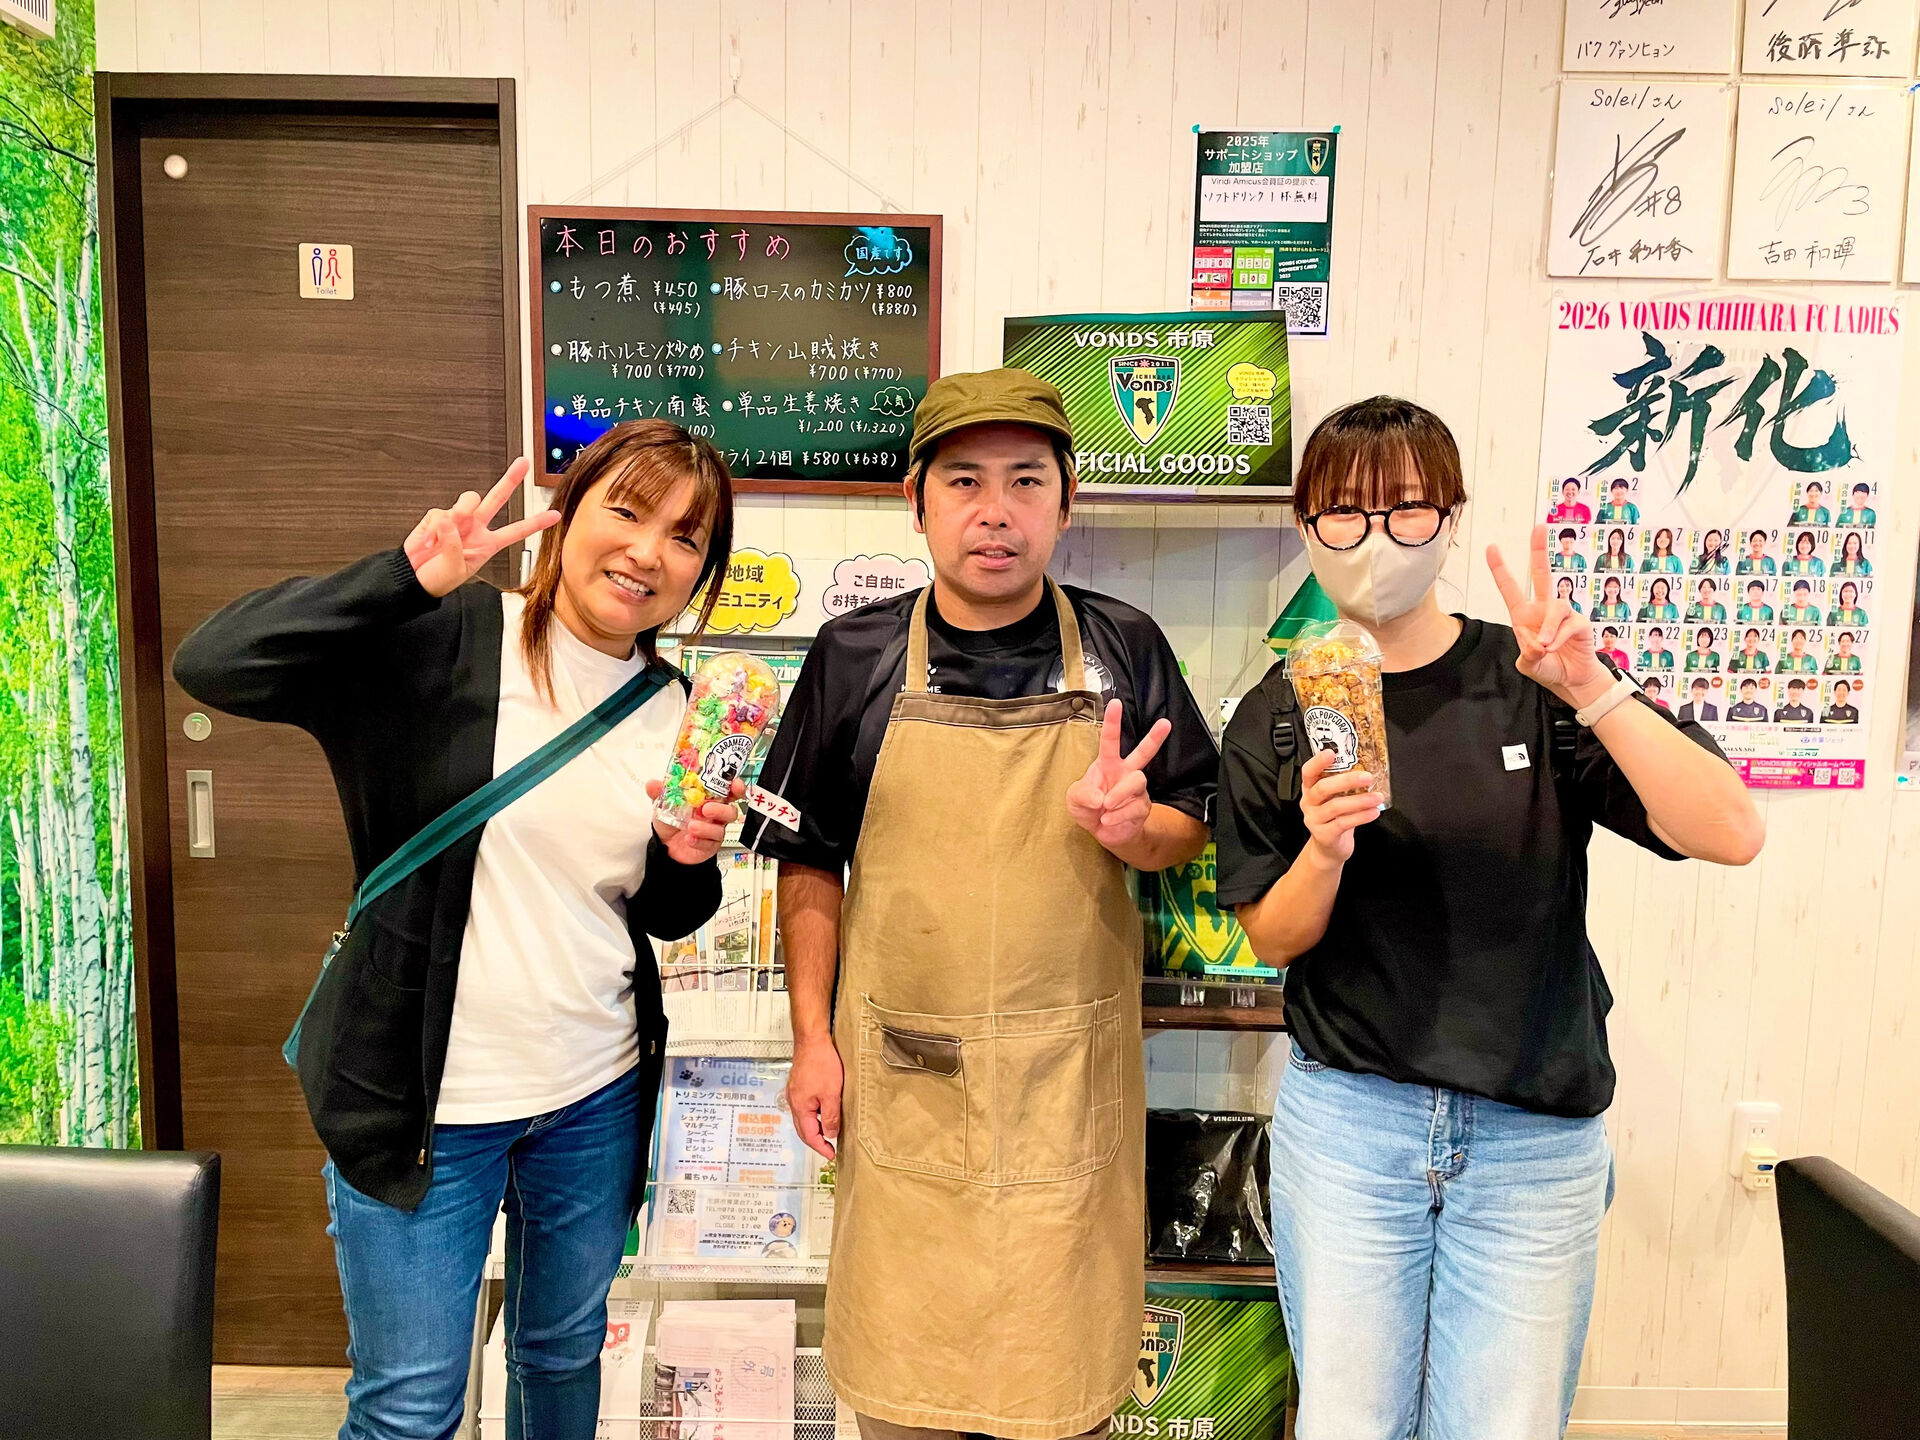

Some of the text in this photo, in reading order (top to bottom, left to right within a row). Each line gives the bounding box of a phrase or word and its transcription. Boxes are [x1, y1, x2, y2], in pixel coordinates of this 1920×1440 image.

[1226, 135, 1270, 148] 2025年
[1204, 148, 1299, 162] サポートショップ
[1228, 162, 1264, 174] 加盟店
[555, 224, 791, 261] 本日のおすすめ
[1758, 240, 1797, 265] 吉田
[316, 287, 337, 295] Toilet
[652, 280, 699, 299] ¥450
[723, 276, 914, 304] 豚ロースのカミカツ ¥800
[652, 301, 702, 319] (¥495)
[871, 303, 918, 317] (¥880)
[1558, 301, 1900, 336] 2026 VONDS ICHIHARA FC LADIES
[1073, 330, 1216, 350] VONDS 市原
[566, 339, 706, 363] 豚ホルモン炒め
[658, 363, 705, 380] (¥770)
[808, 363, 903, 382] ¥700 (¥770)
[570, 393, 713, 420] 単品チキン南蛮
[737, 390, 861, 419] 単品生姜焼き
[883, 395, 906, 409] 人気
[1578, 331, 1863, 501] 新化
[798, 418, 844, 435] ¥1,200
[717, 448, 898, 467] ライ2個 ¥580 (¥638)
[1075, 452, 1252, 475] FICIAL GOODS
[1552, 478, 1560, 492] 山田
[1631, 477, 1639, 491] 2
[1824, 480, 1832, 494] 3
[1871, 481, 1878, 495] 4
[1579, 526, 1587, 540] 5
[1627, 526, 1635, 541] 6
[1675, 527, 1684, 541] 7
[1723, 528, 1731, 542] 8
[1771, 529, 1779, 543] 9
[1817, 529, 1829, 544] 10
[1864, 531, 1876, 545] 11
[854, 574, 905, 590] ご自由に
[1575, 575, 1588, 589] 13
[1623, 575, 1635, 590] 14
[1671, 576, 1683, 590] 15
[1718, 577, 1730, 592] 16
[1765, 578, 1779, 592] 17
[1813, 579, 1826, 593] 18
[1860, 580, 1873, 594] 19
[715, 591, 784, 611] ミュニティ
[1618, 625, 1632, 639] 21
[1665, 626, 1680, 641] 22
[1713, 627, 1728, 641] 23
[1761, 628, 1776, 642] 24
[1808, 629, 1823, 643] 25
[1854, 630, 1870, 644] 27
[1662, 674, 1675, 689] 31
[1319, 711, 1349, 734] POPCORN
[675, 1090, 756, 1101] トリミングご利用料金
[684, 1122, 720, 1130] マルチーズ
[1140, 1338, 1176, 1353] NDS
[1109, 1414, 1216, 1440] NDS 市原
